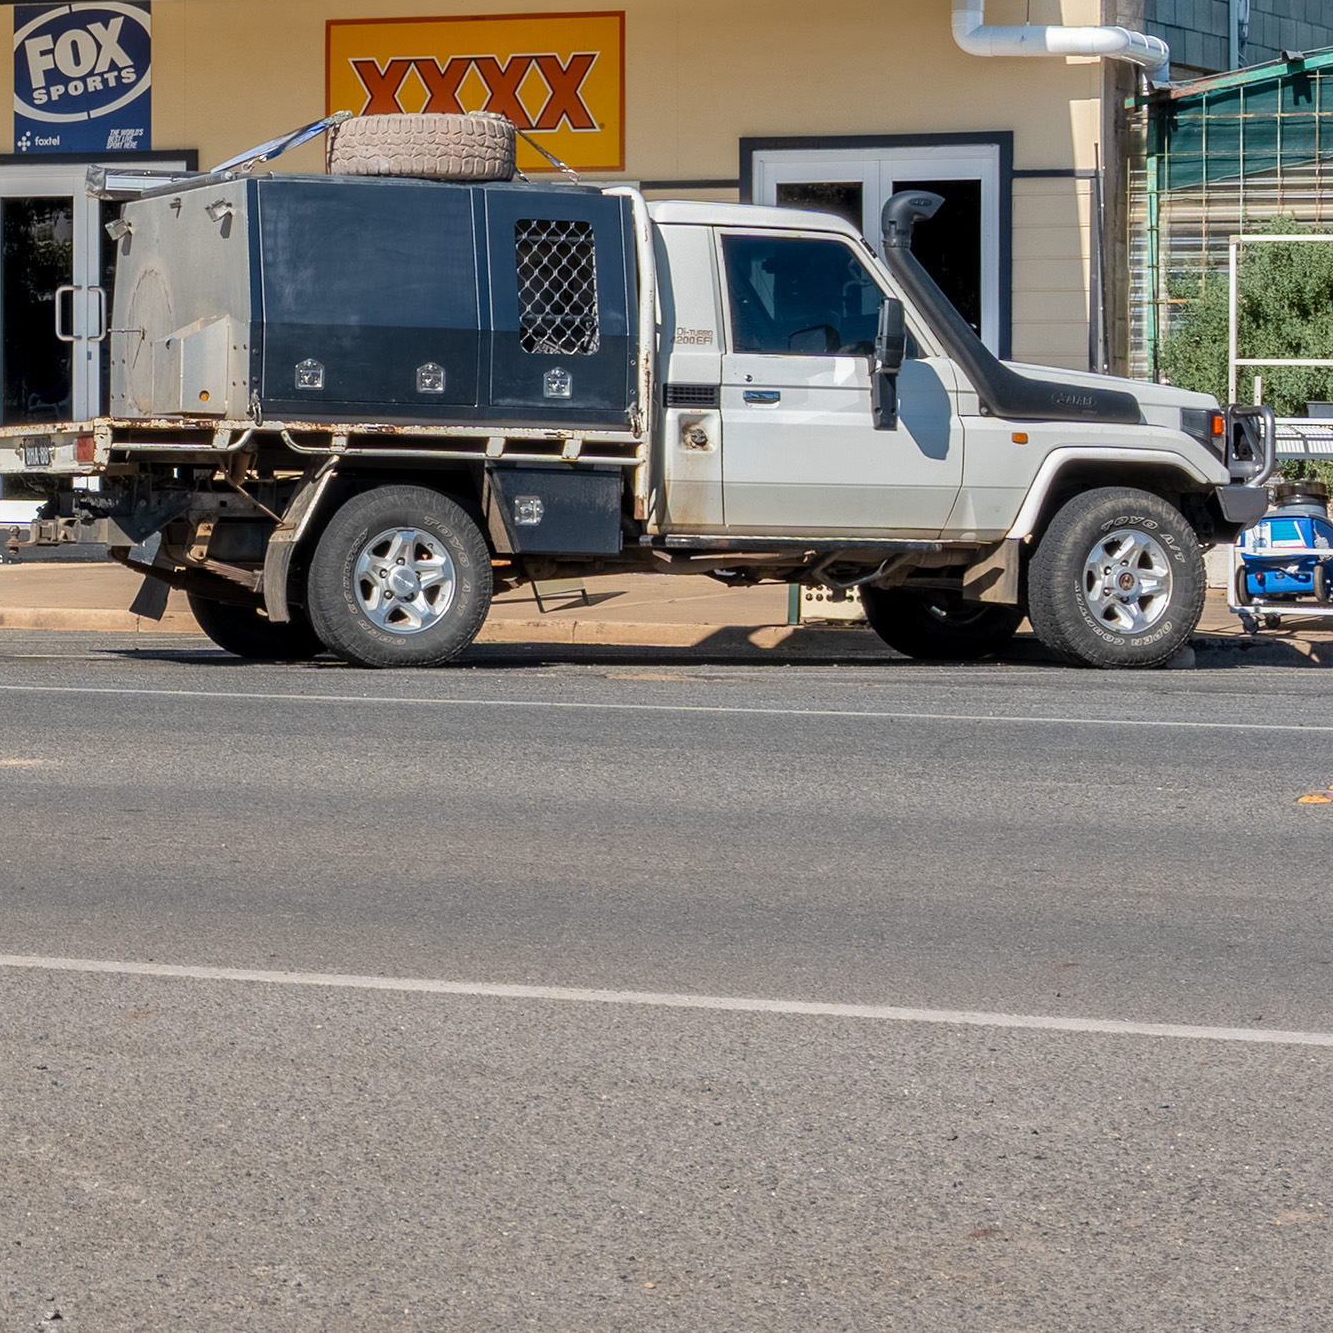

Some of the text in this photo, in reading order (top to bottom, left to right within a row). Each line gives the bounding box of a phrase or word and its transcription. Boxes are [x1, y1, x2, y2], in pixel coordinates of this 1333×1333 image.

[24, 16, 134, 89] FOX
[32, 67, 137, 105] SPORTS
[348, 51, 601, 132] XXXX
[34, 135, 60, 146] foxtel
[1100, 515, 1158, 532] TOYO
[424, 516, 471, 568] TOYO
[357, 619, 407, 646] OPEN
[1130, 620, 1174, 646] OPEN
